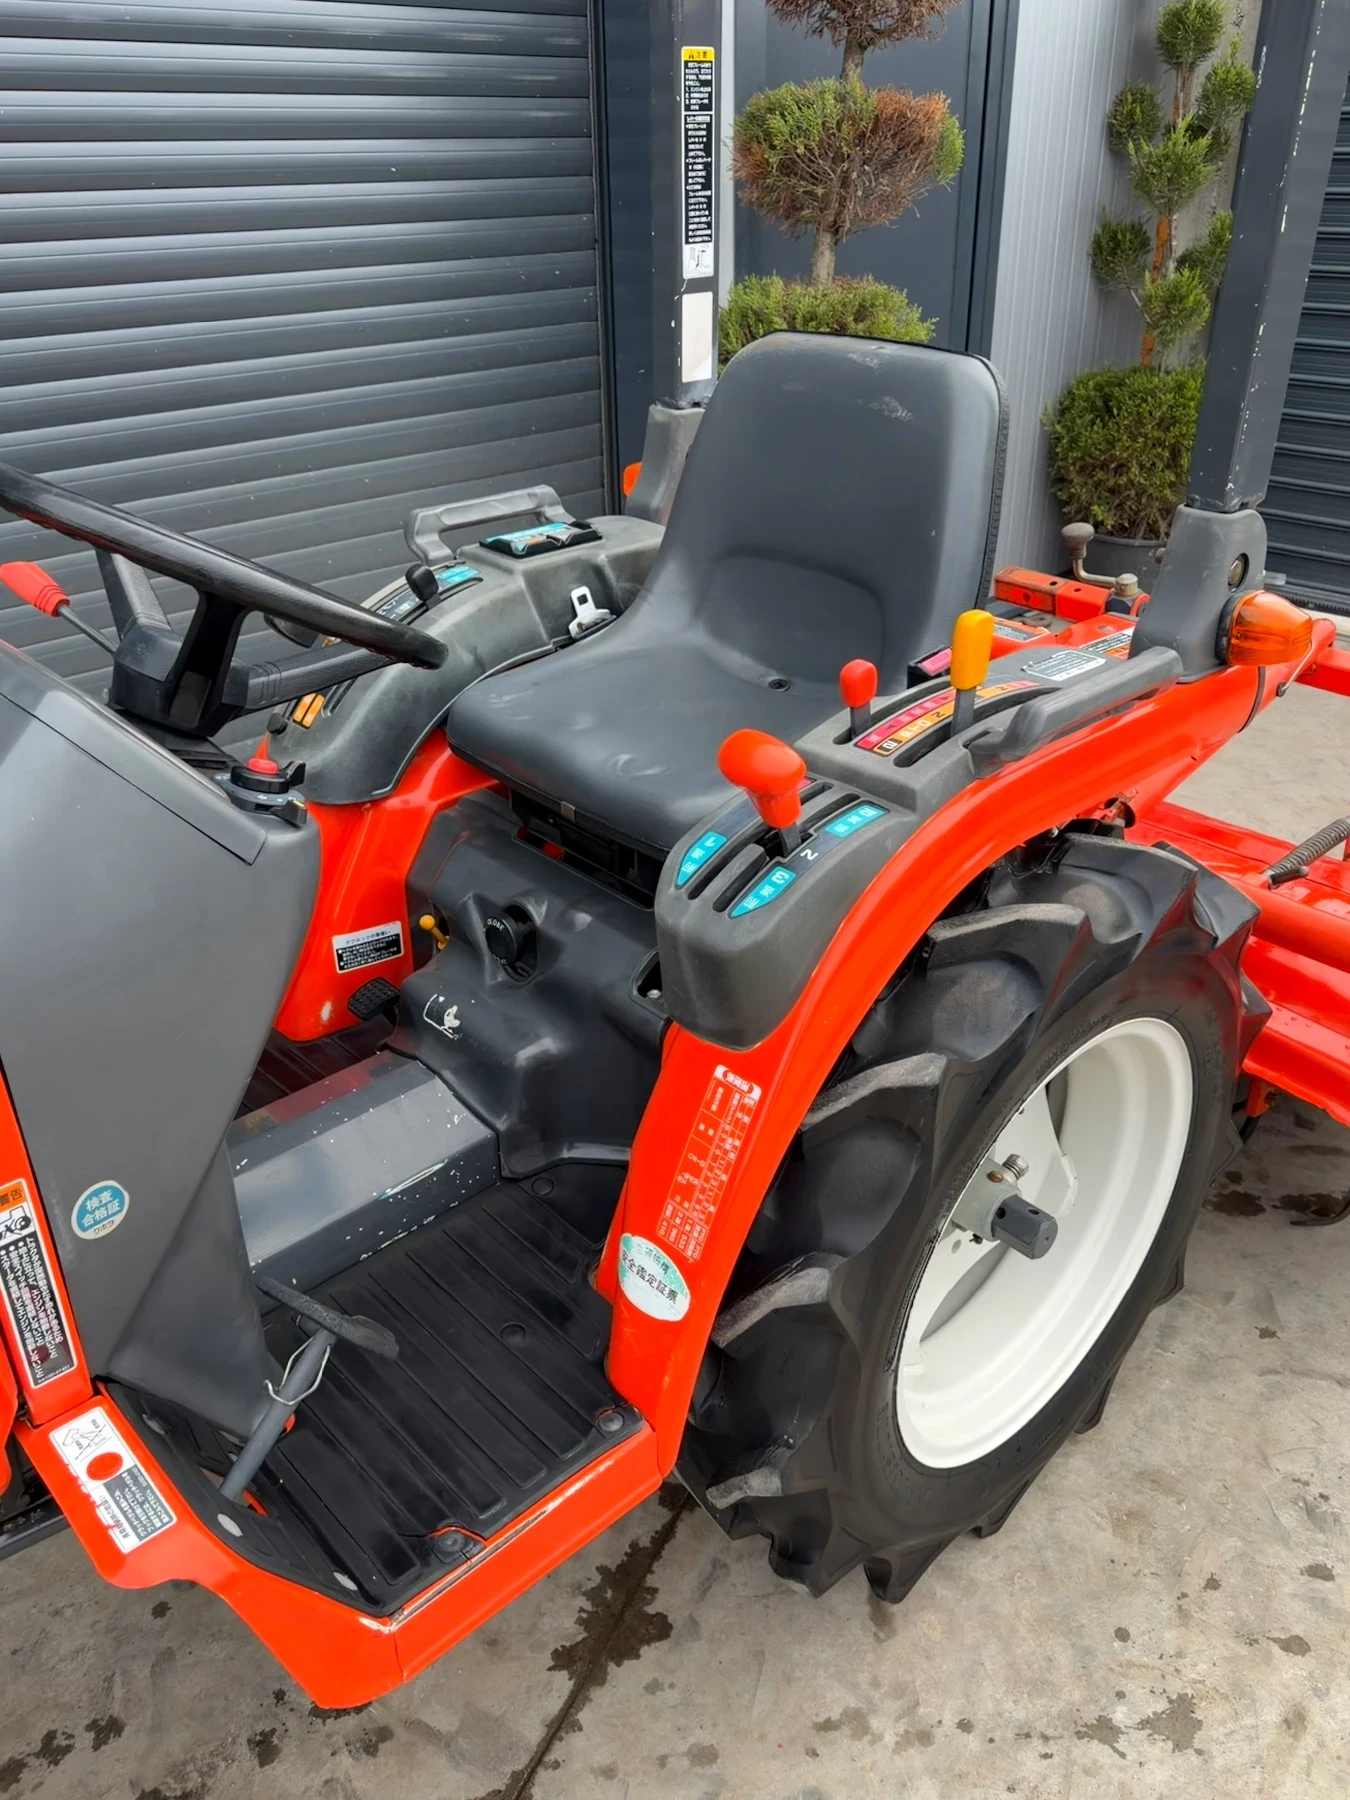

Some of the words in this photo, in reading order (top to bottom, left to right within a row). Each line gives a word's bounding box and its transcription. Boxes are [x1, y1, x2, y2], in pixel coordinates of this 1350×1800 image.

[800, 849, 819, 861] N
[86, 1189, 113, 1212] 検査
[82, 1199, 121, 1228] 合格証
